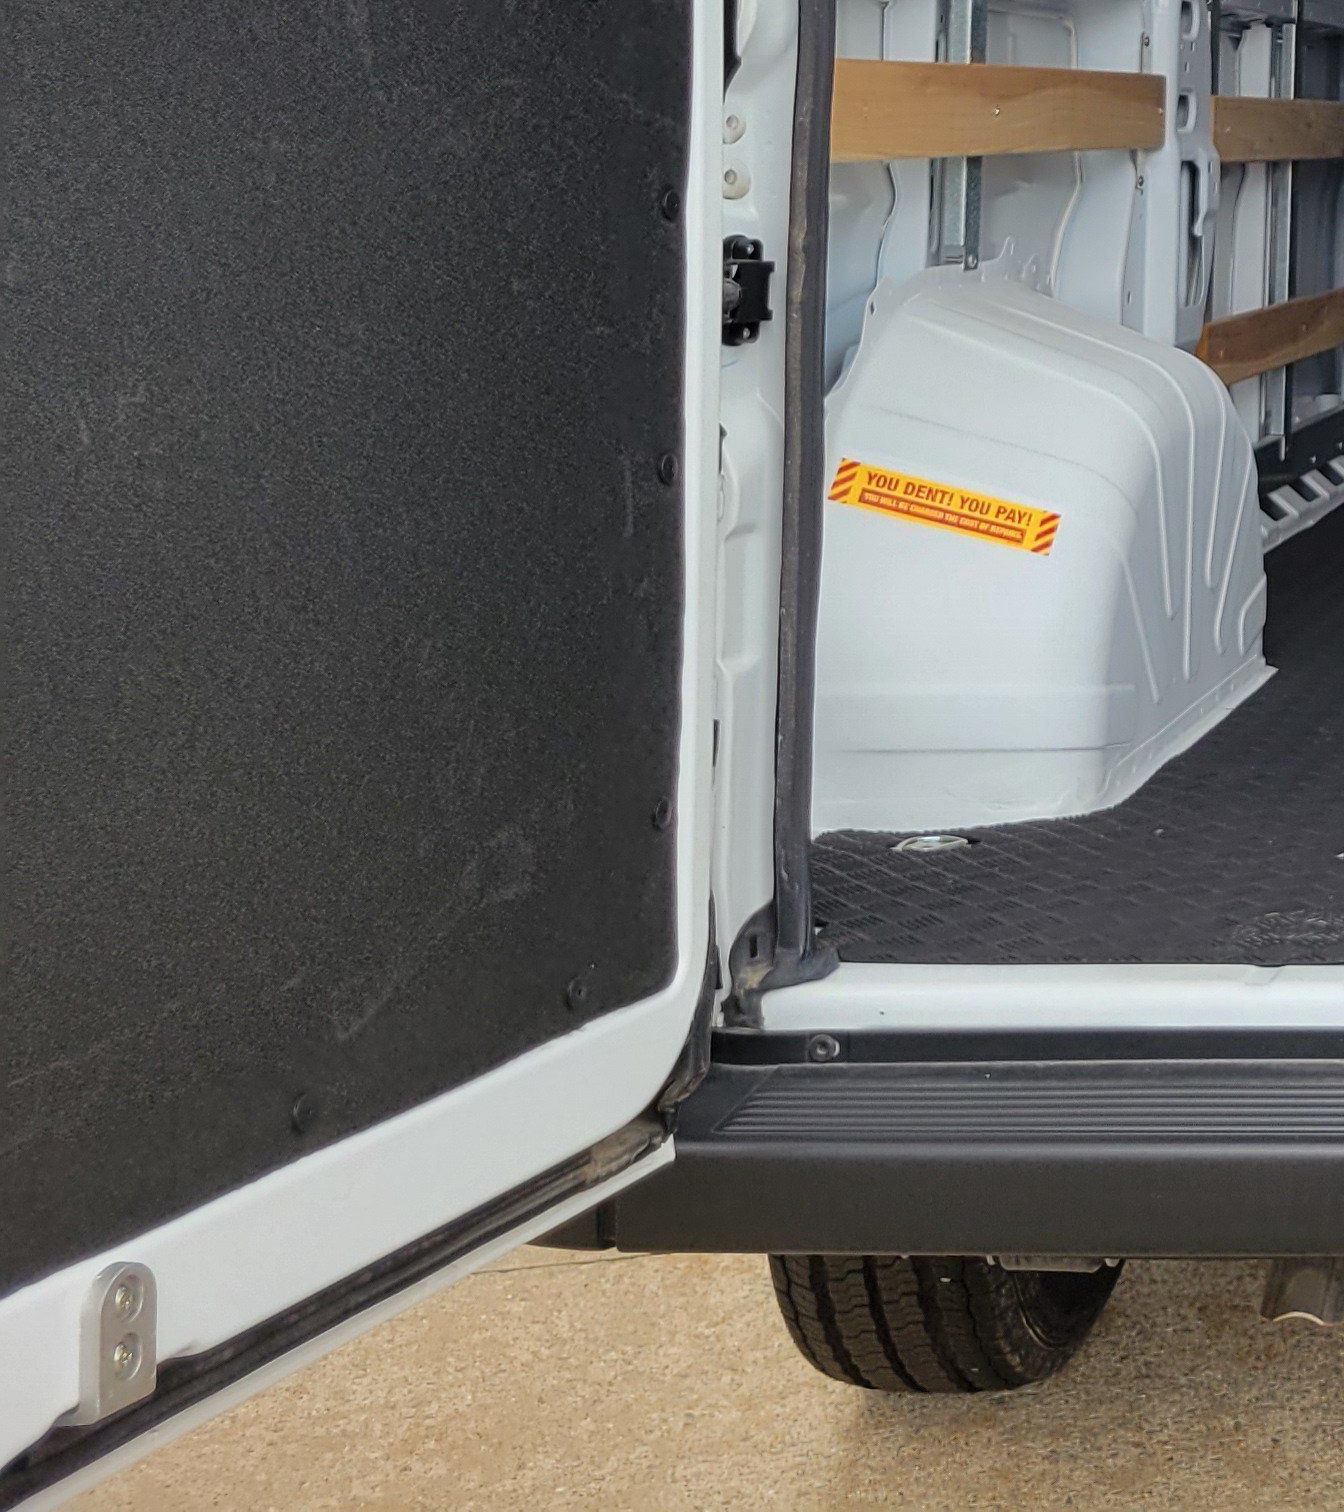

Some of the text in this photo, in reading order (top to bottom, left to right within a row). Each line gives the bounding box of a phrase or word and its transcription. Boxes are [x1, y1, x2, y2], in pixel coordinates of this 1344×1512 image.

[867, 470, 1034, 527] YOU DENT! YOU PAY!
